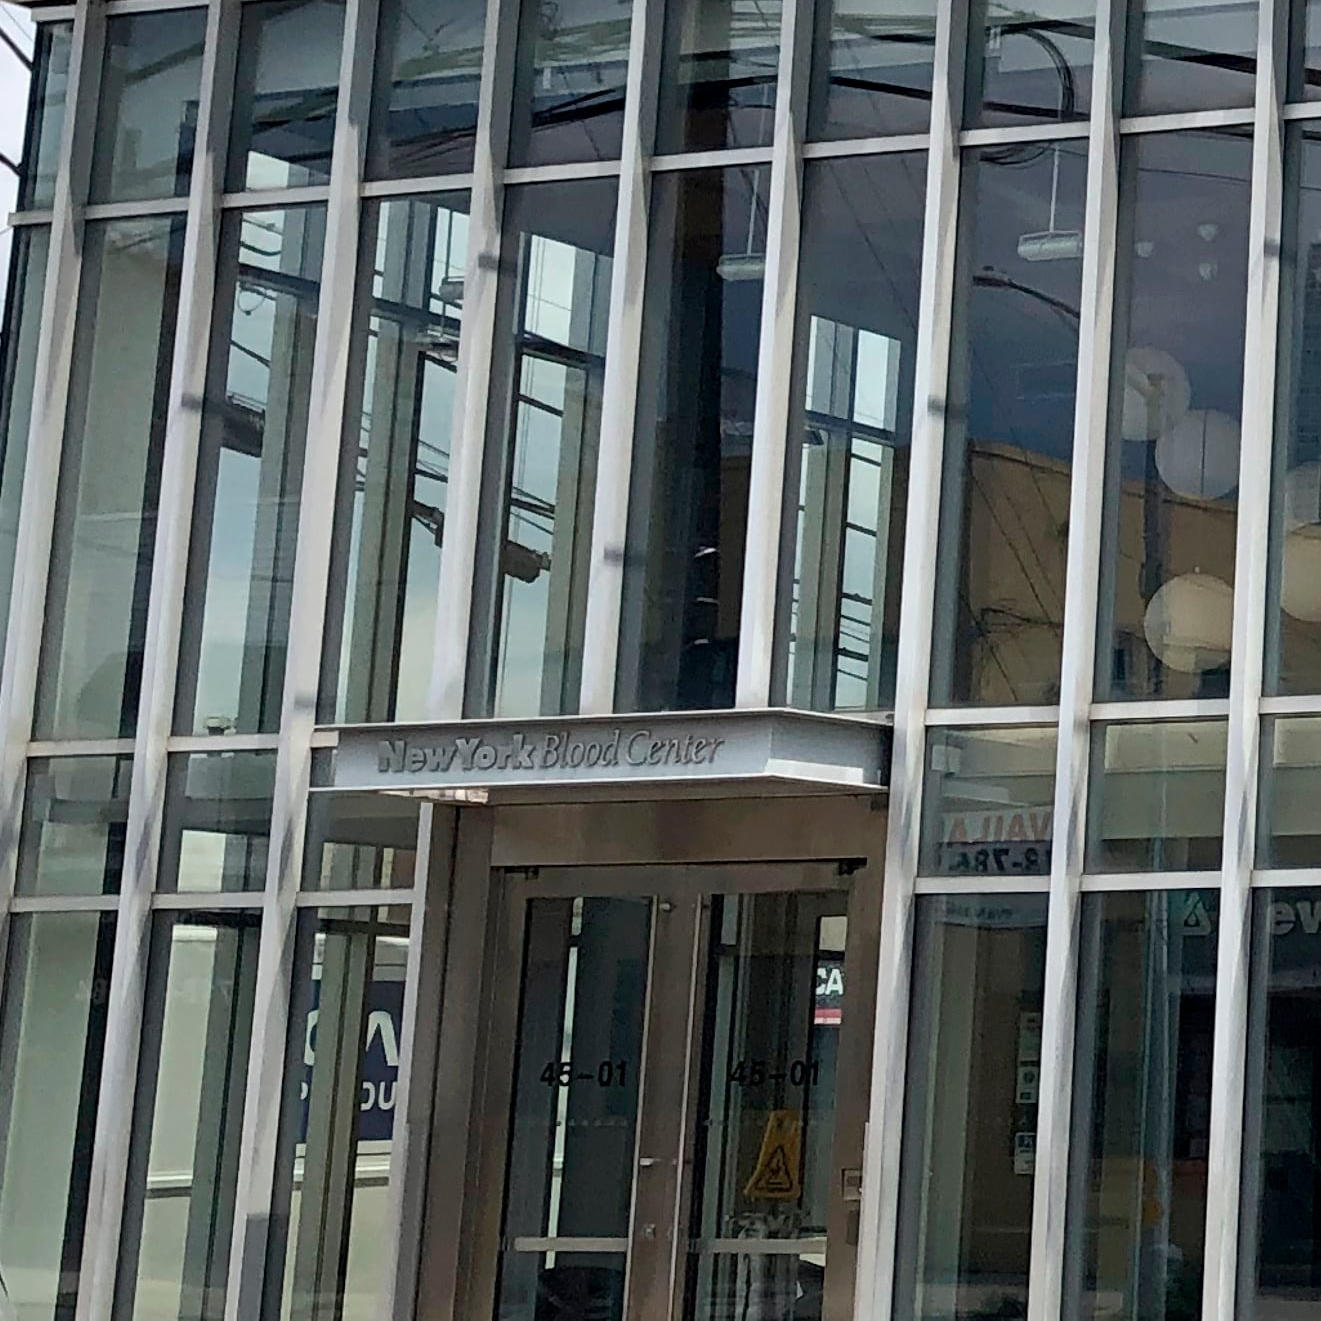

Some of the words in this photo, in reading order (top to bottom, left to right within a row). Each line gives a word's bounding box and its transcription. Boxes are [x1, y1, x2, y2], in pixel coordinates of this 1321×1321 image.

[377, 739, 459, 775] New
[456, 733, 535, 772] York
[540, 728, 621, 770] Blood
[626, 728, 725, 767] Center
[727, 1059, 820, 1087] 45-01
